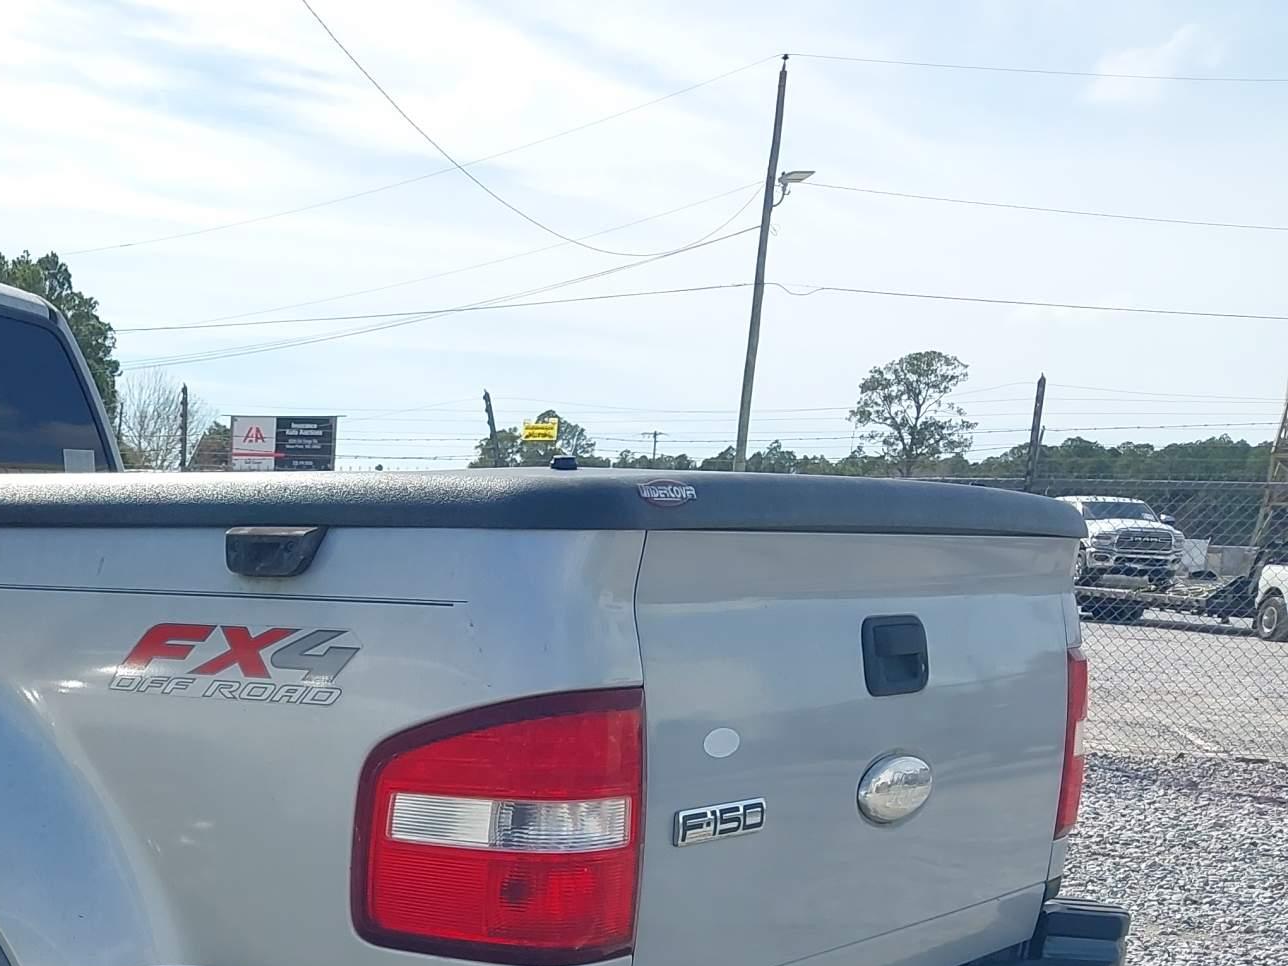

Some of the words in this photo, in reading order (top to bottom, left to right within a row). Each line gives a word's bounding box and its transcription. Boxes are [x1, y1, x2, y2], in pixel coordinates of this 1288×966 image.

[114, 622, 362, 682] FX4
[108, 674, 197, 695] OFF
[202, 679, 344, 706] ROAD
